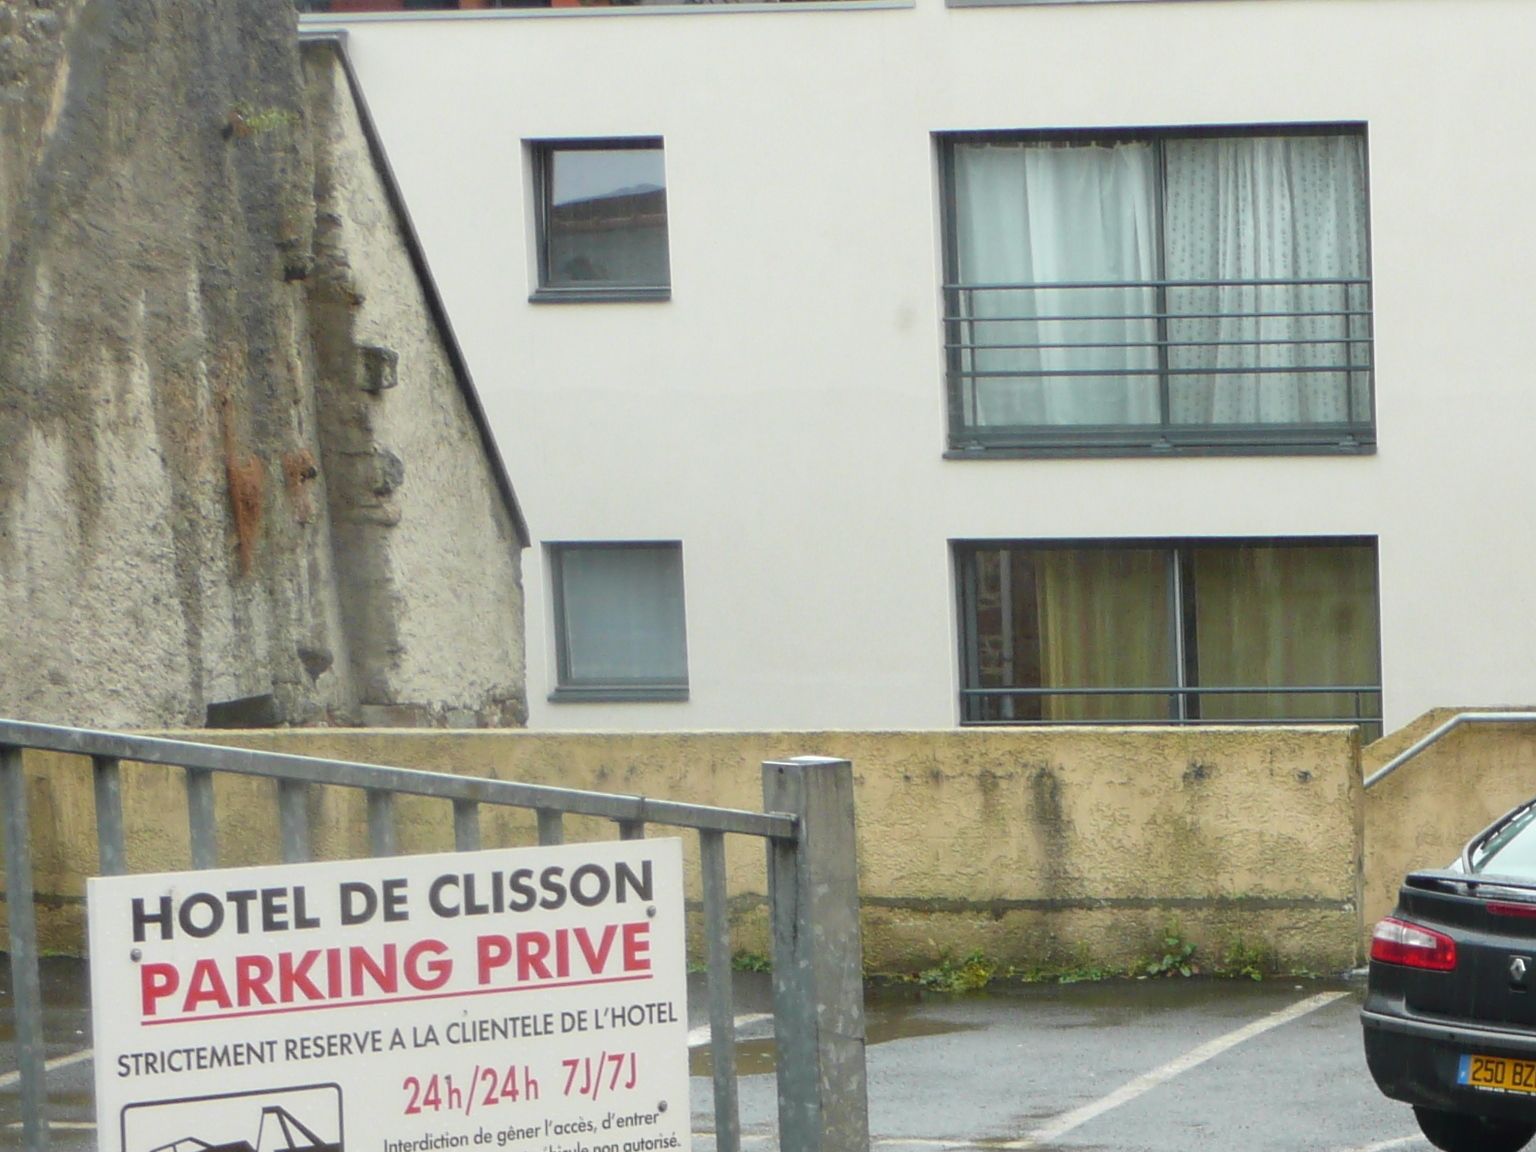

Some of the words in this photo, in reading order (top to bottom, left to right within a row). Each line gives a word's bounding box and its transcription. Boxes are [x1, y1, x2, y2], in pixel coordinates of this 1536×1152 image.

[132, 886, 320, 942] HOTEL
[340, 878, 408, 926] DE
[429, 860, 654, 918] CLISSON
[141, 939, 452, 1016] PARKING
[477, 922, 651, 984] PRIVE
[118, 1040, 277, 1077] STRICTEMENT
[285, 1030, 381, 1060] RESERVE
[389, 1028, 406, 1050] A
[413, 1025, 439, 1048] LA
[446, 1013, 554, 1044] CLIENTELE
[561, 1010, 588, 1033] DE
[595, 1002, 678, 1029] L'HOTEL
[562, 1051, 637, 1101] 7J/7J
[1472, 1059, 1505, 1084] 250
[473, 1127, 492, 1145] de
[497, 1125, 541, 1146] gêner
[545, 1116, 597, 1136] l'accès,
[602, 1111, 659, 1130] d'entrer
[623, 1131, 681, 1152] autorisé.
